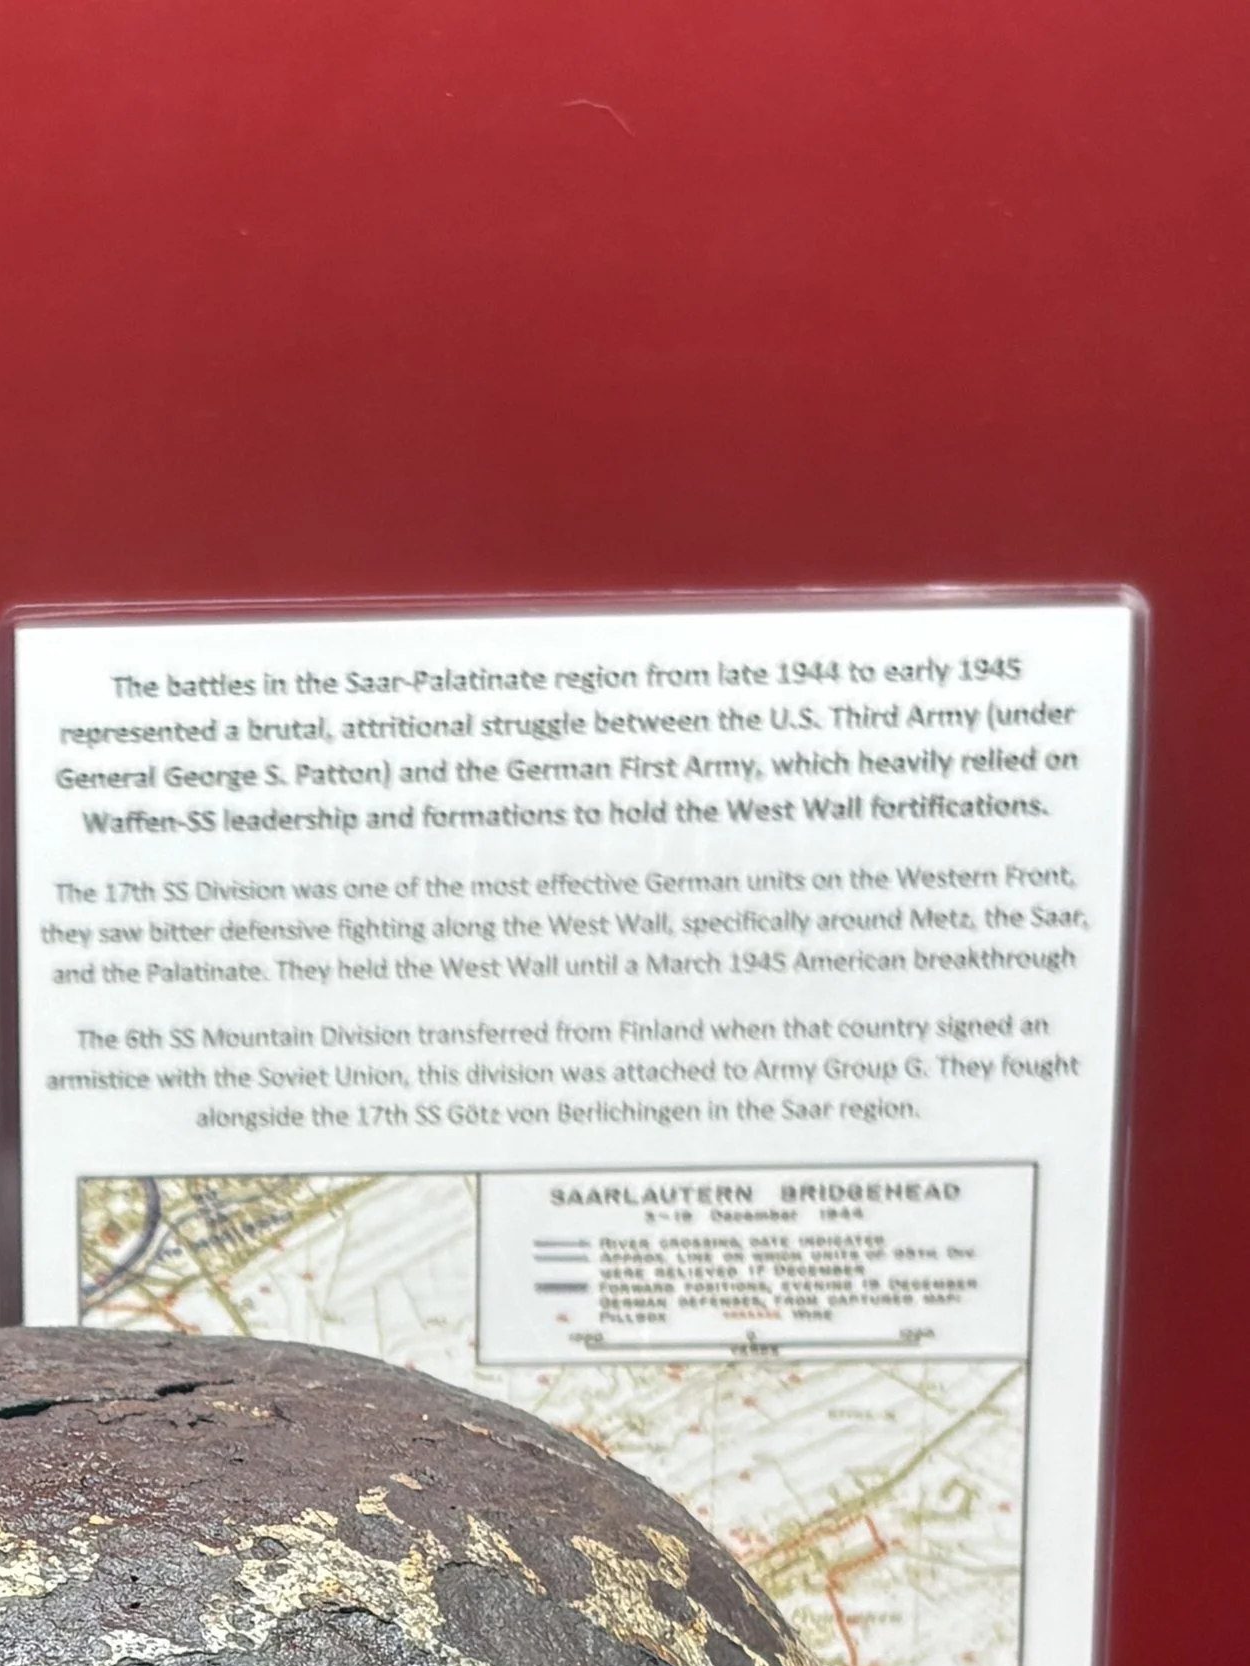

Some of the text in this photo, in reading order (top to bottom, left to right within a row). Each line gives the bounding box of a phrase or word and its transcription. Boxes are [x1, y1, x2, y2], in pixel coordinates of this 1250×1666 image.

[111, 657, 1022, 698] The battles in the Saar-Palatinate region from late 1944 to early 1945
[60, 703, 1077, 749] represented a brutal, attritional struggle between the U.S. Third Army (under
[82, 794, 1049, 835] Waffen-SS leadership and formations to hold the West Wall fortifications.
[76, 1015, 1050, 1050] The 6th SS Mountain Division transferred from Finland when that country signed an
[195, 1105, 305, 1133] alongside
[311, 1105, 350, 1127] the
[358, 1103, 408, 1127] 17th
[415, 1103, 442, 1126] SS
[506, 1107, 550, 1125] von
[557, 1100, 701, 1127] Berlichingen
[707, 1100, 729, 1121] in
[736, 1098, 776, 1121] the
[782, 1098, 833, 1121] Saar
[550, 1181, 963, 1206] SAARLAUTERN BRIDGEHEAD
